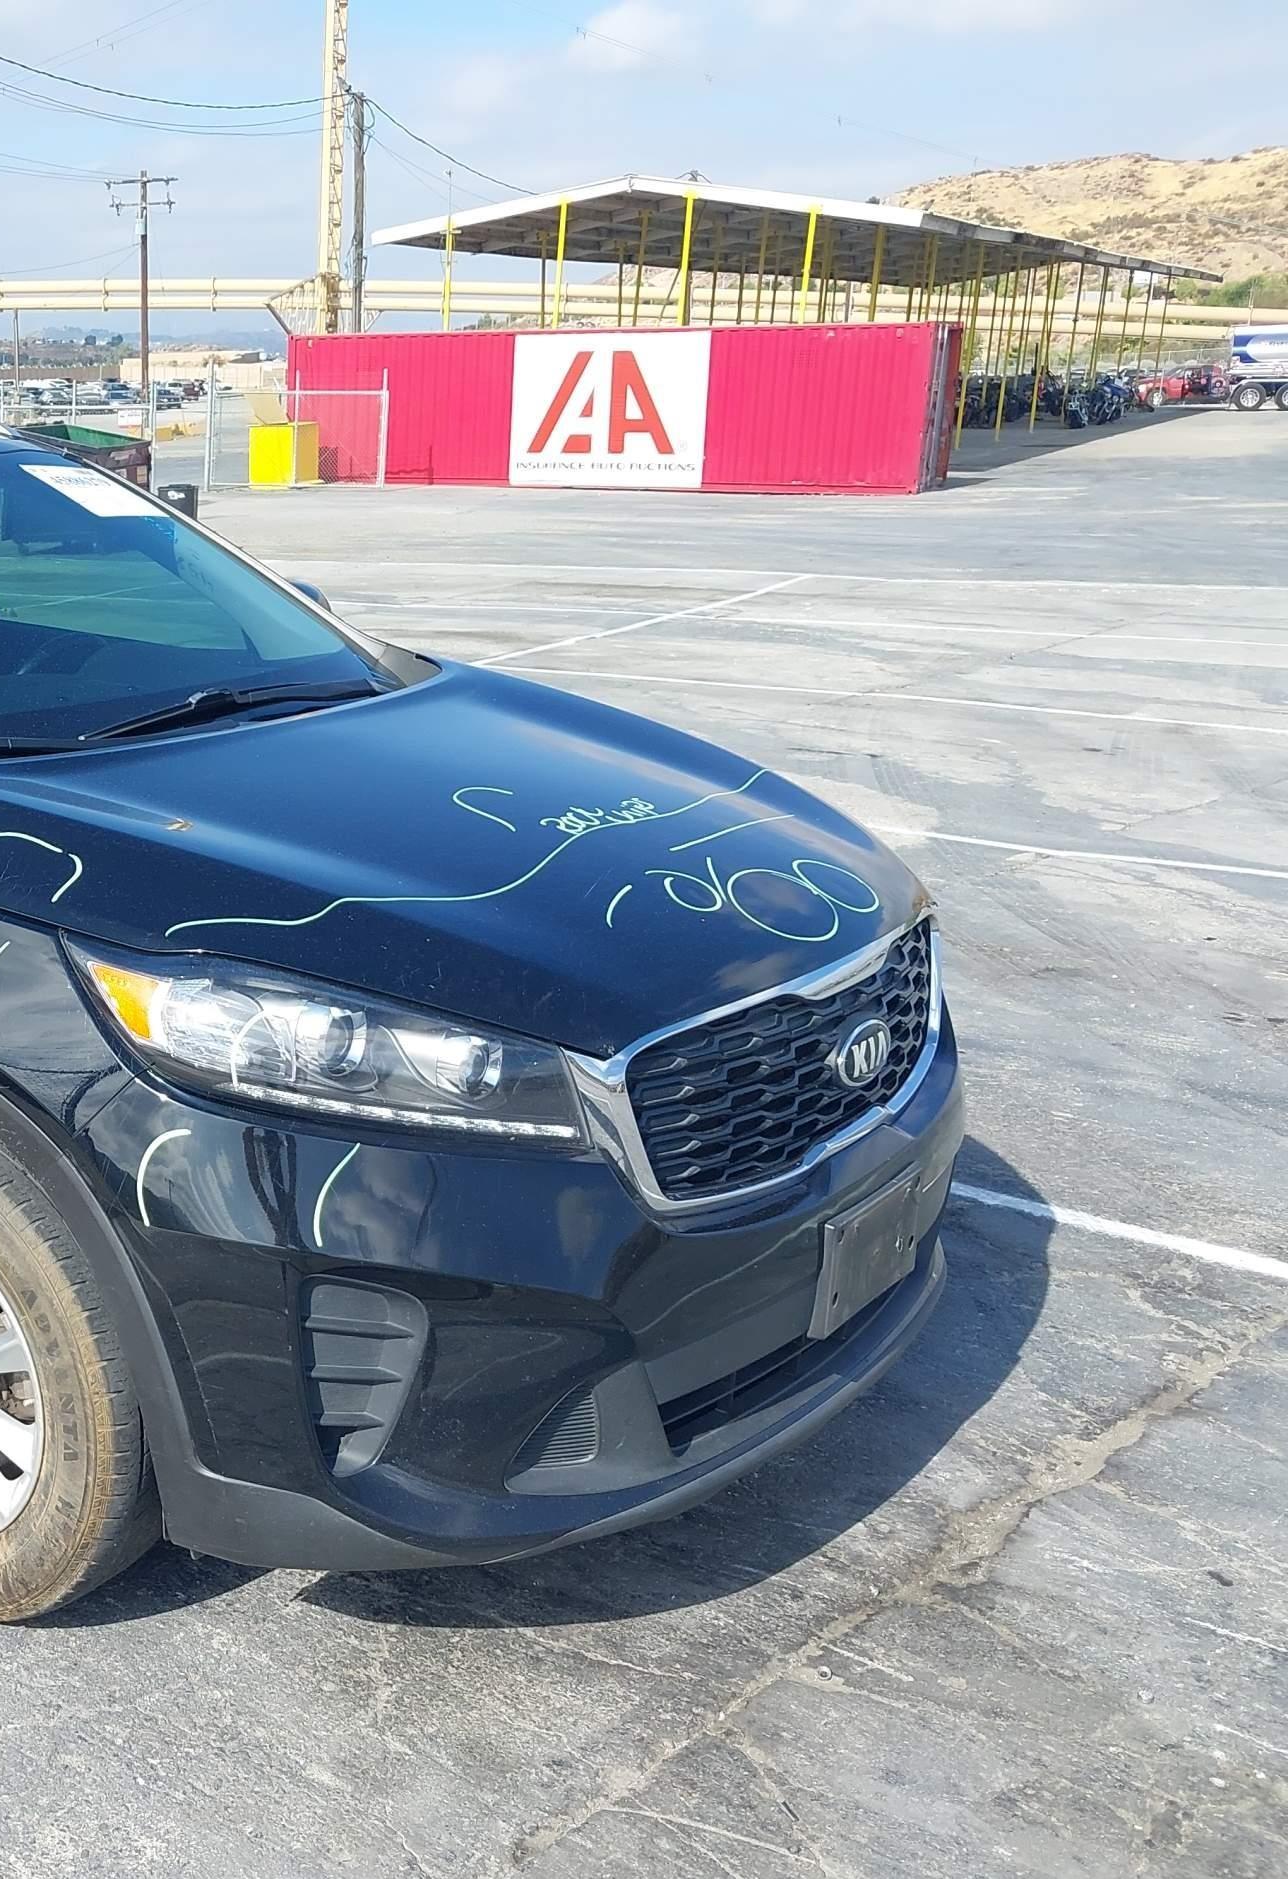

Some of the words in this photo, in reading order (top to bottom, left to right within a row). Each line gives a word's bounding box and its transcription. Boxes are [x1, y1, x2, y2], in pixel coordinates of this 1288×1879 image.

[516, 462, 585, 470] INSURANCE
[630, 463, 696, 472] AUCTIONS
[851, 1030, 888, 1078] KIA
